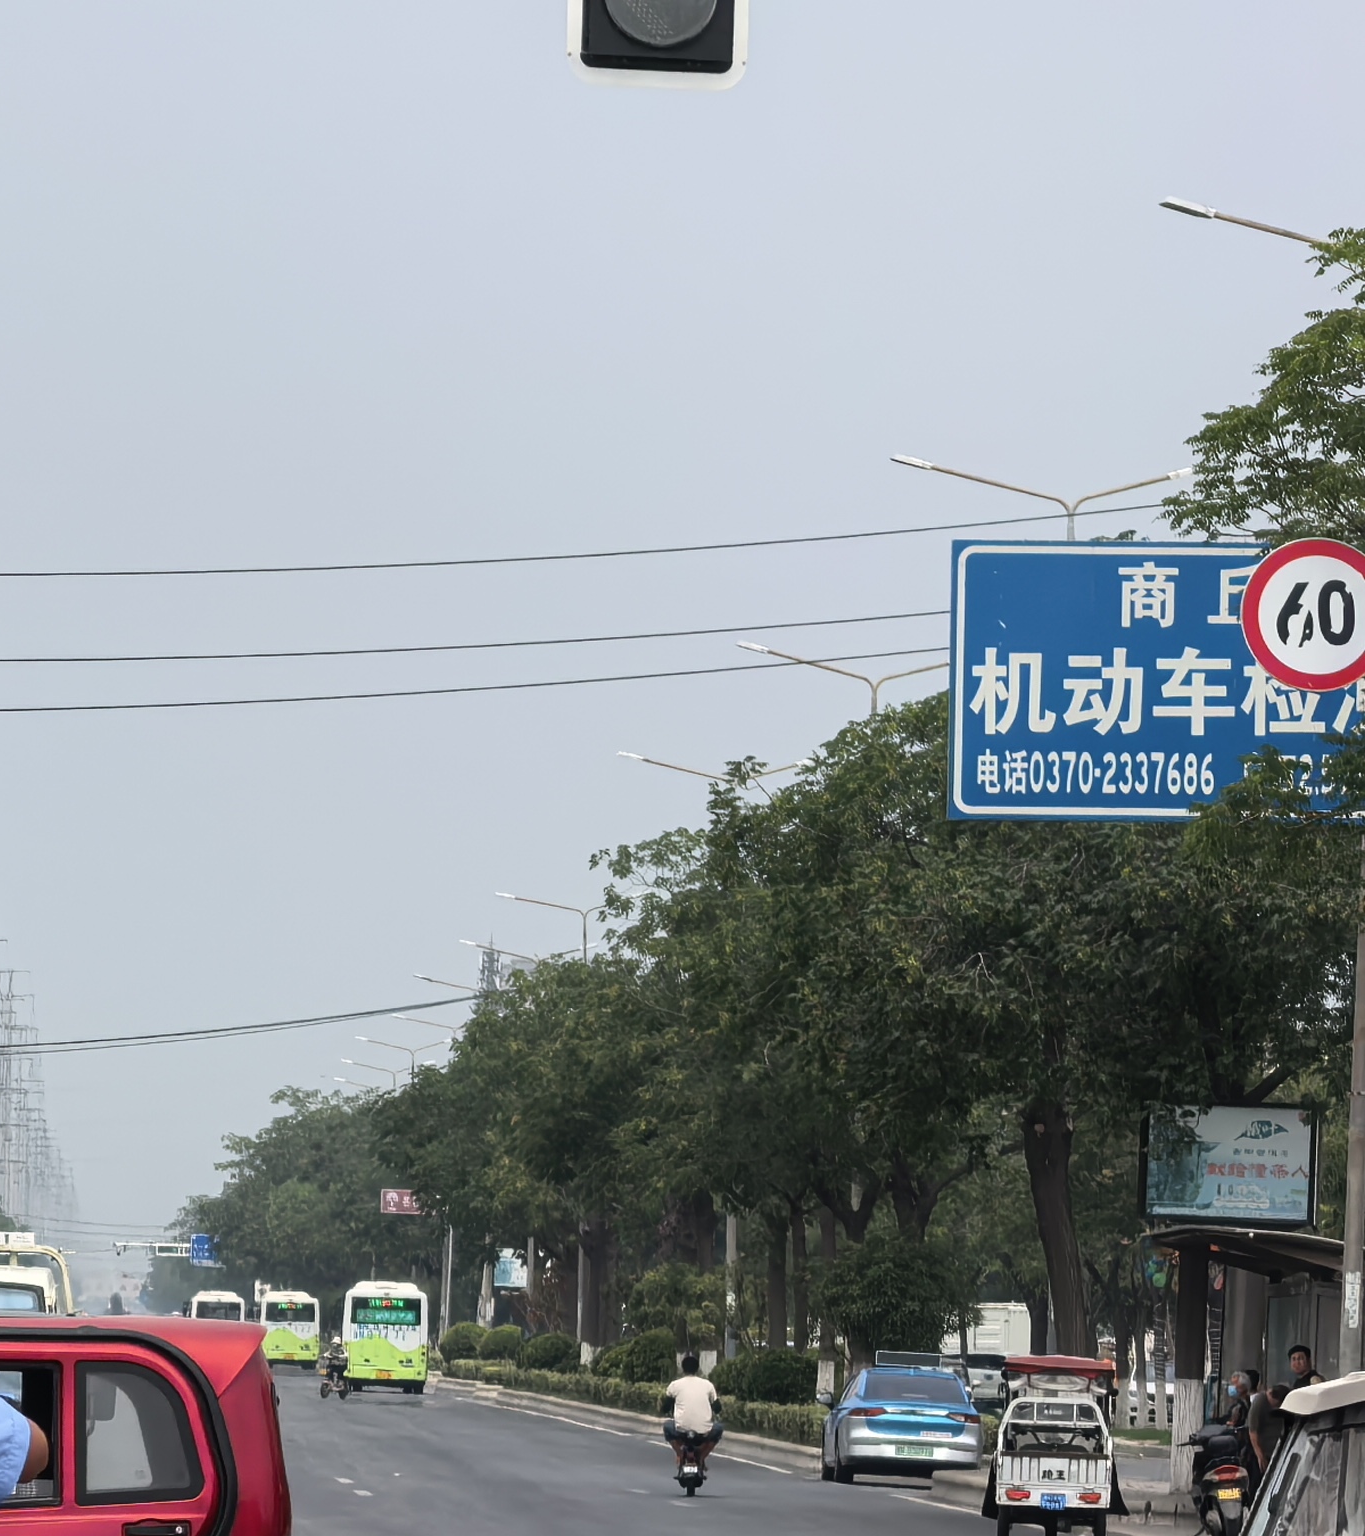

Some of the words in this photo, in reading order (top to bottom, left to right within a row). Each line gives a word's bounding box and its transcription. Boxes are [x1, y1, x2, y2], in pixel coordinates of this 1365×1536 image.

[1276, 579, 1356, 648] 60
[970, 646, 1365, 736] 机动车检
[977, 749, 1215, 796] 电话0370-2337686
